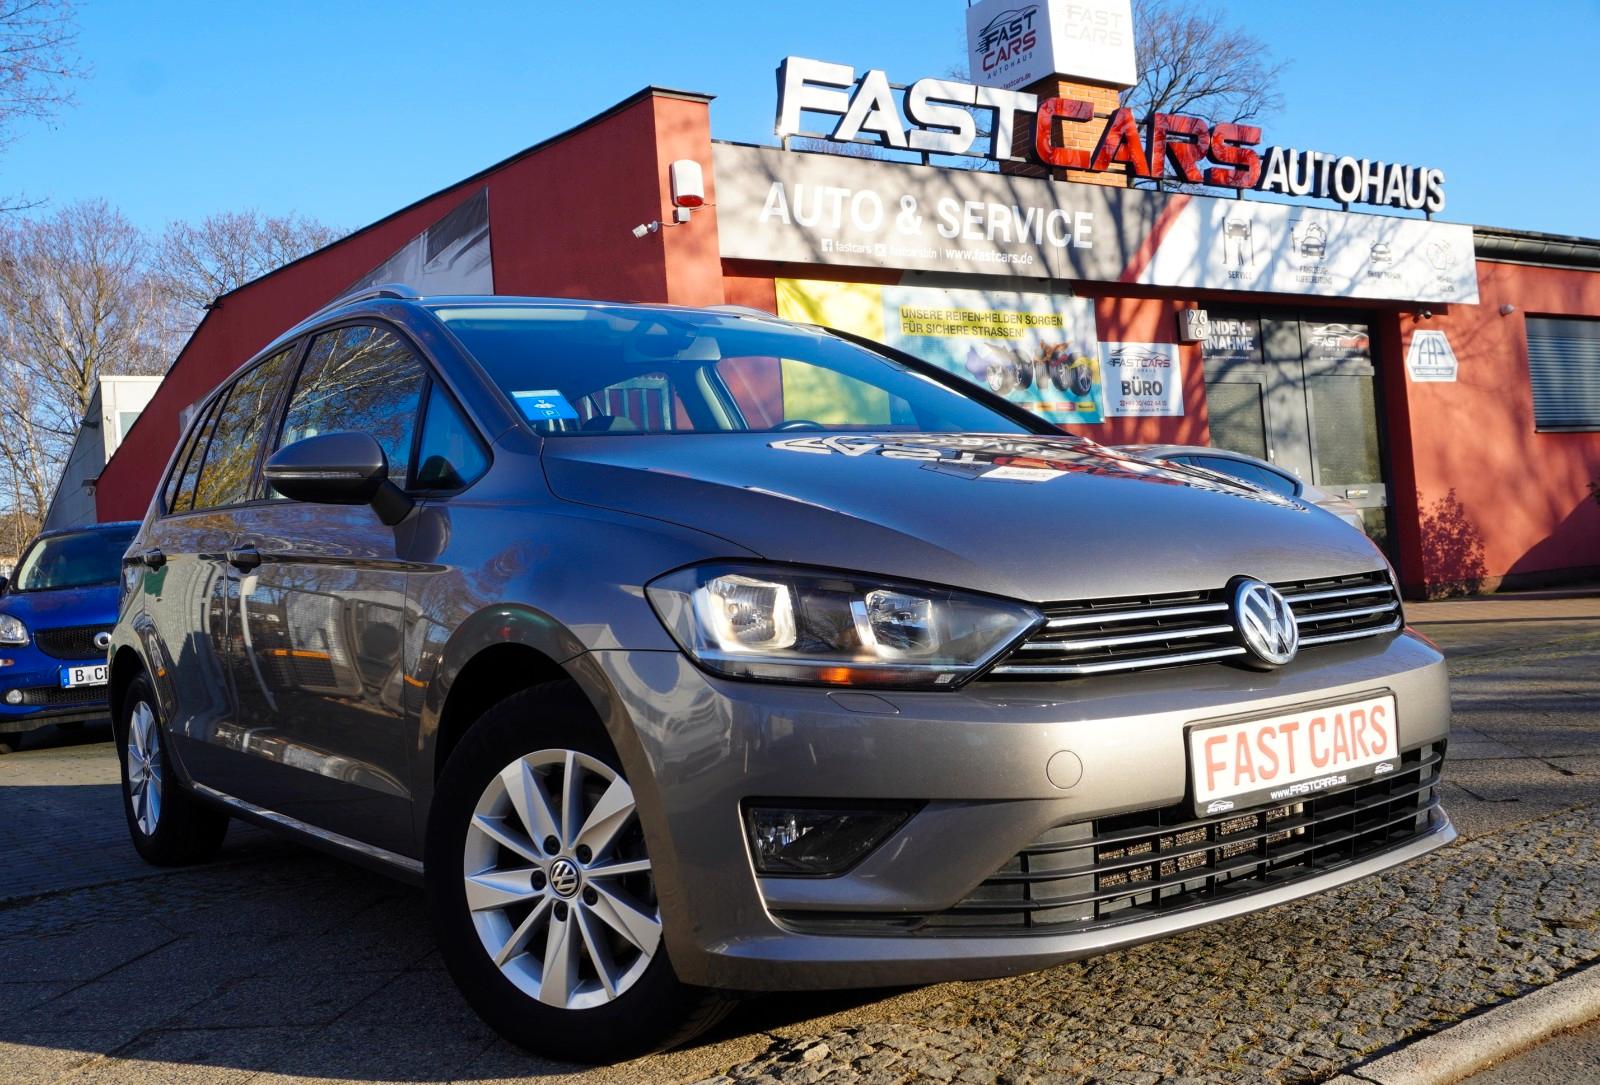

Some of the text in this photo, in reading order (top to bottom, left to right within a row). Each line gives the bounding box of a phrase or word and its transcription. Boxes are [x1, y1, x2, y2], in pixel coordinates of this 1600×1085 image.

[981, 9, 1037, 52] FAST
[982, 29, 1036, 72] CARS
[1261, 146, 1446, 213] AUTOHAUS
[759, 182, 1094, 250] AUTO & SERVICE
[946, 248, 1033, 265] www.fastcars.de
[901, 309, 1063, 326] UNSERE REIFEN-HELDEN SORGEN
[1187, 309, 1207, 325] 26
[902, 321, 1024, 337] FÜR SICHERE STRASSEN!
[1201, 335, 1254, 351] NNAHME
[1121, 376, 1163, 396] BÜRO
[75, 669, 85, 683] B
[1204, 704, 1388, 792] FAST CARS
